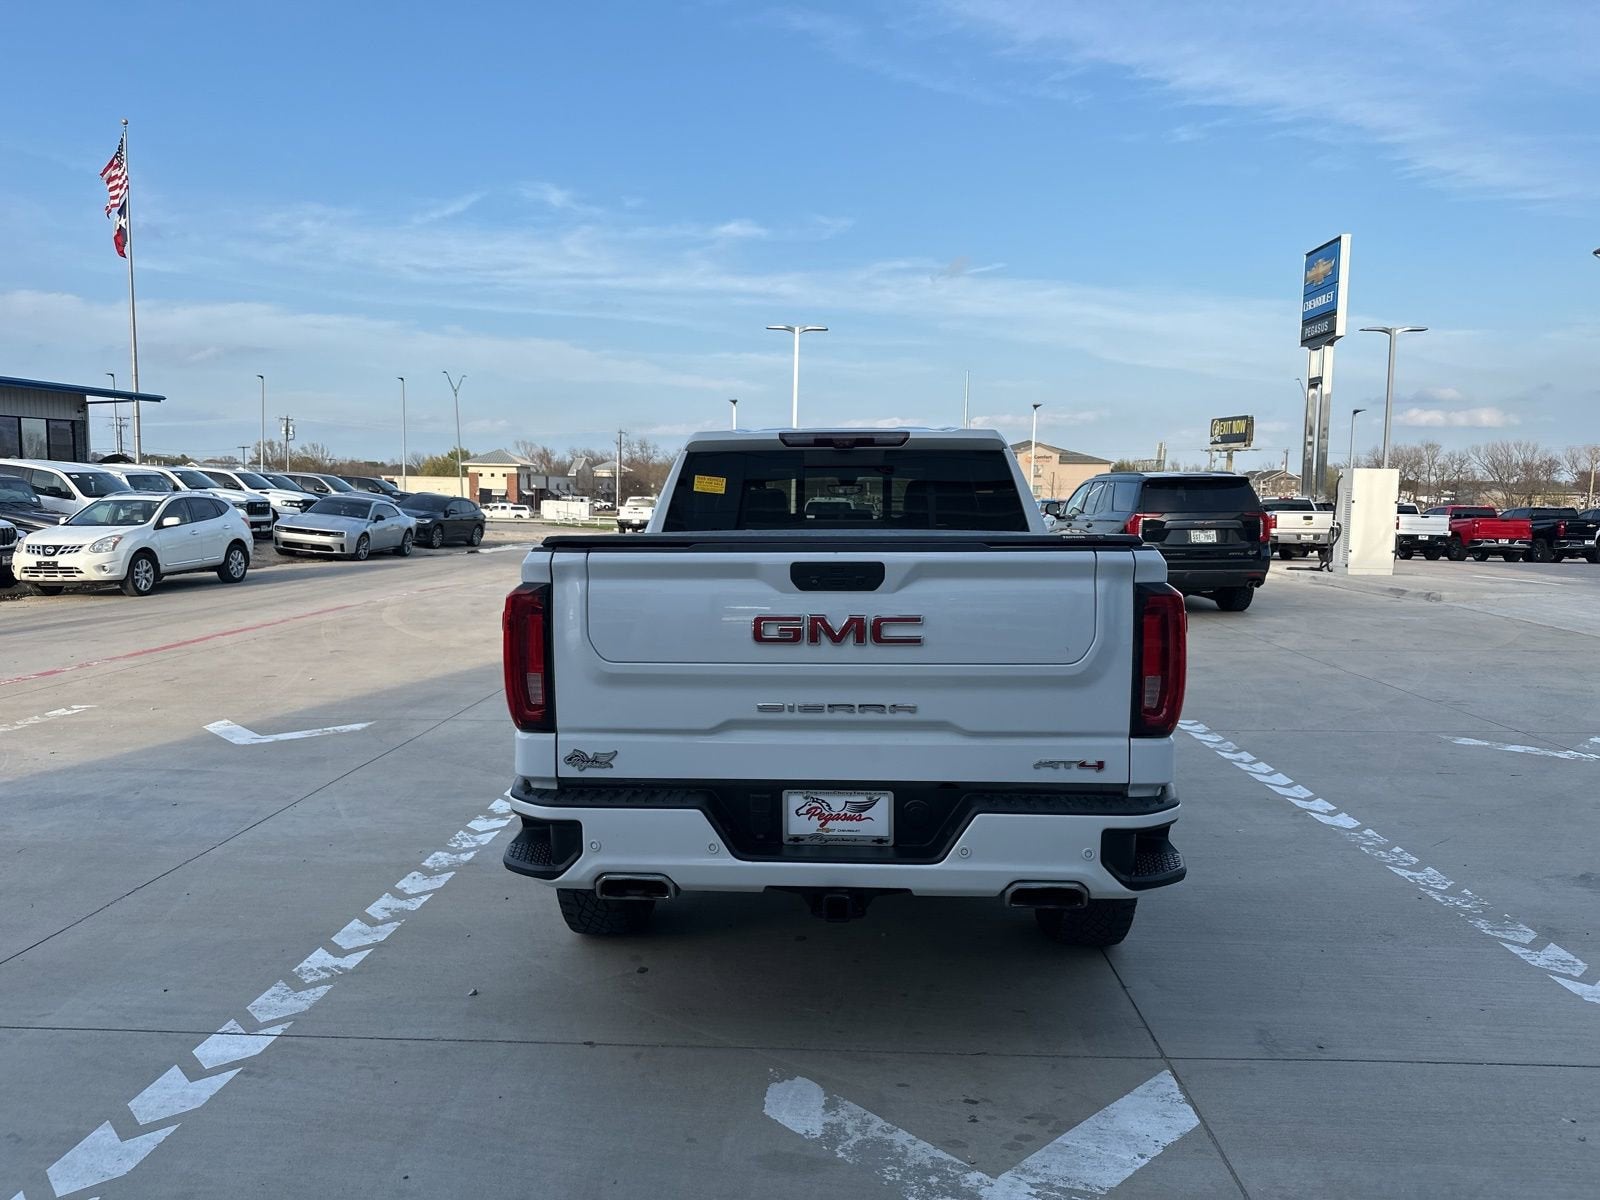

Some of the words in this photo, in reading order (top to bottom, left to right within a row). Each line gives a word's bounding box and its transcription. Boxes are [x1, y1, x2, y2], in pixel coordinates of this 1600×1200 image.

[1303, 291, 1335, 312] CHEVROLET
[1304, 321, 1329, 337] PEGASUS
[1220, 421, 1232, 435] EXIT
[1232, 419, 1247, 434] NOW
[752, 614, 924, 646] GMC
[757, 702, 918, 714] SIERRA
[1033, 759, 1105, 773] AT4
[805, 806, 874, 828] Pegasus
